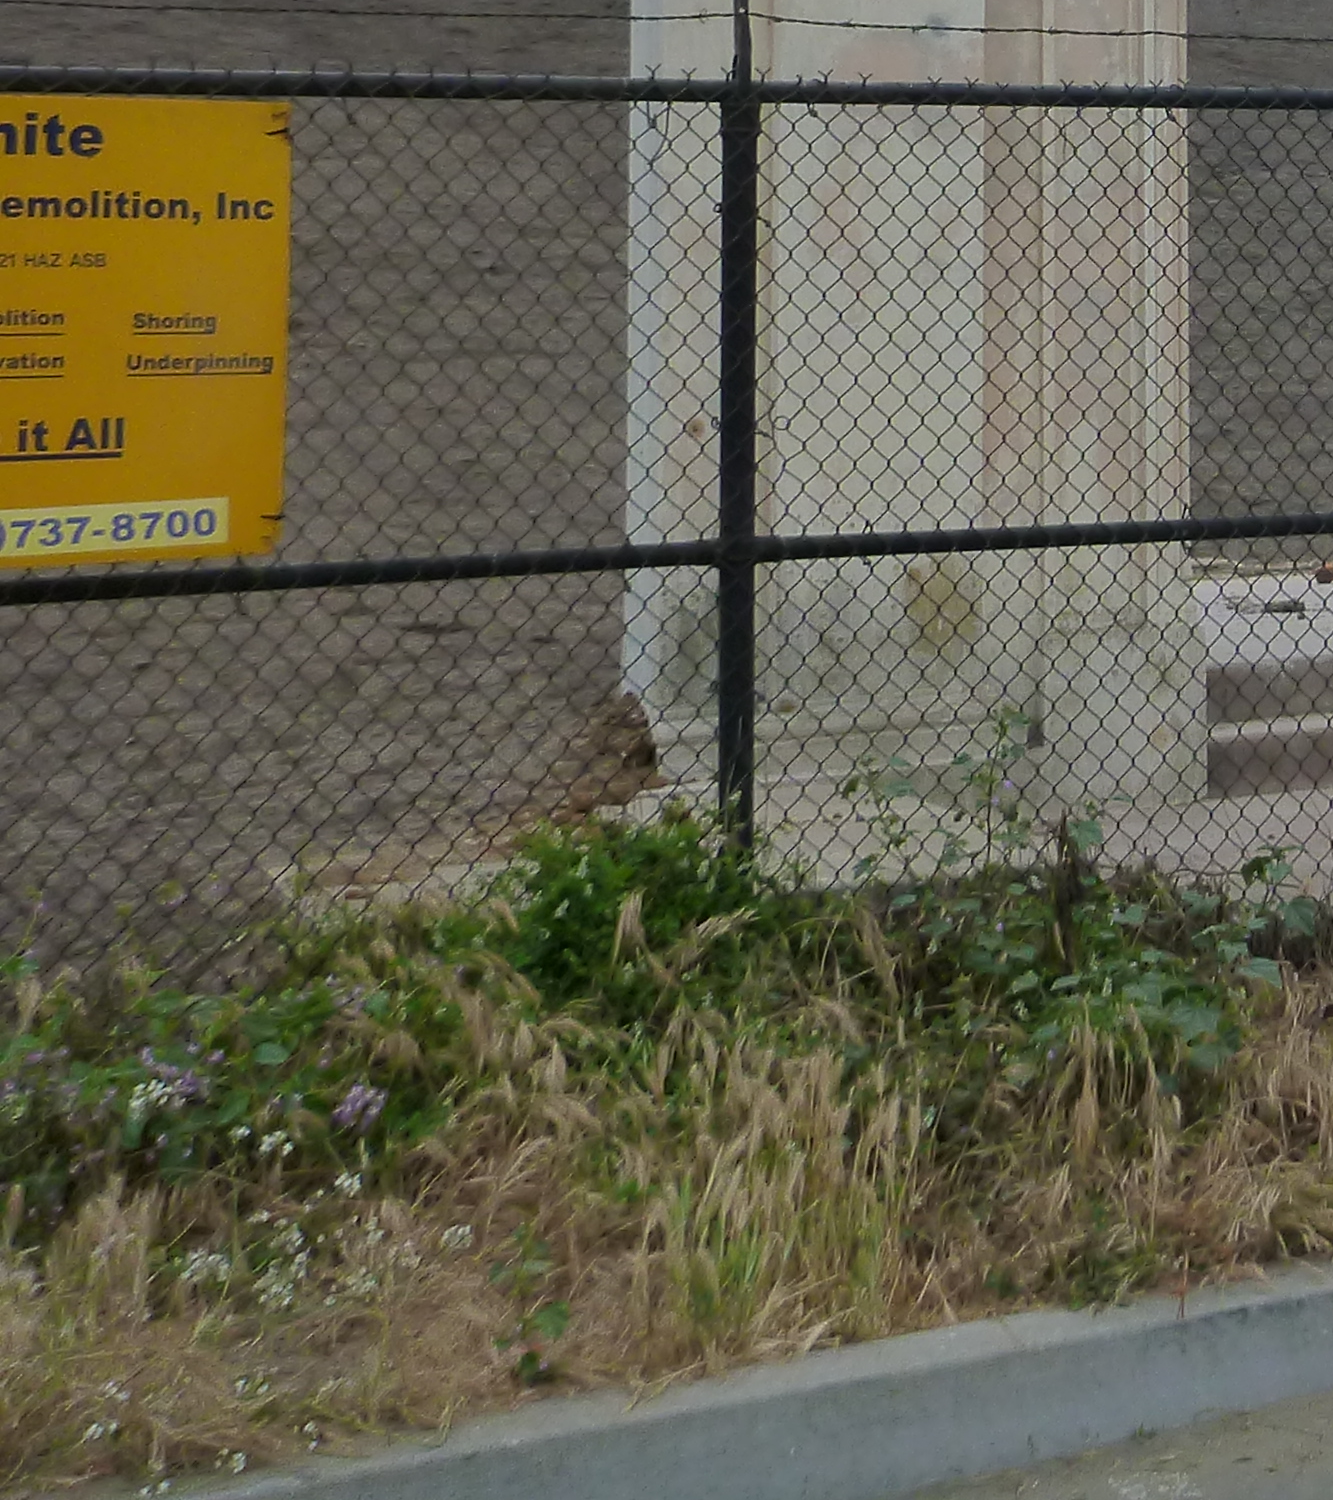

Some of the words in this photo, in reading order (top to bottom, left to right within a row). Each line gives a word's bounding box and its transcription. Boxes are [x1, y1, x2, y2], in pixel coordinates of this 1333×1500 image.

[1, 190, 201, 225] emolition,
[217, 192, 275, 220] Inc
[24, 253, 62, 268] HAZ
[70, 252, 107, 268] ASB
[133, 311, 217, 334] Shoring
[126, 352, 274, 374] Underpinning
[17, 420, 49, 452] it
[65, 417, 125, 452] All
